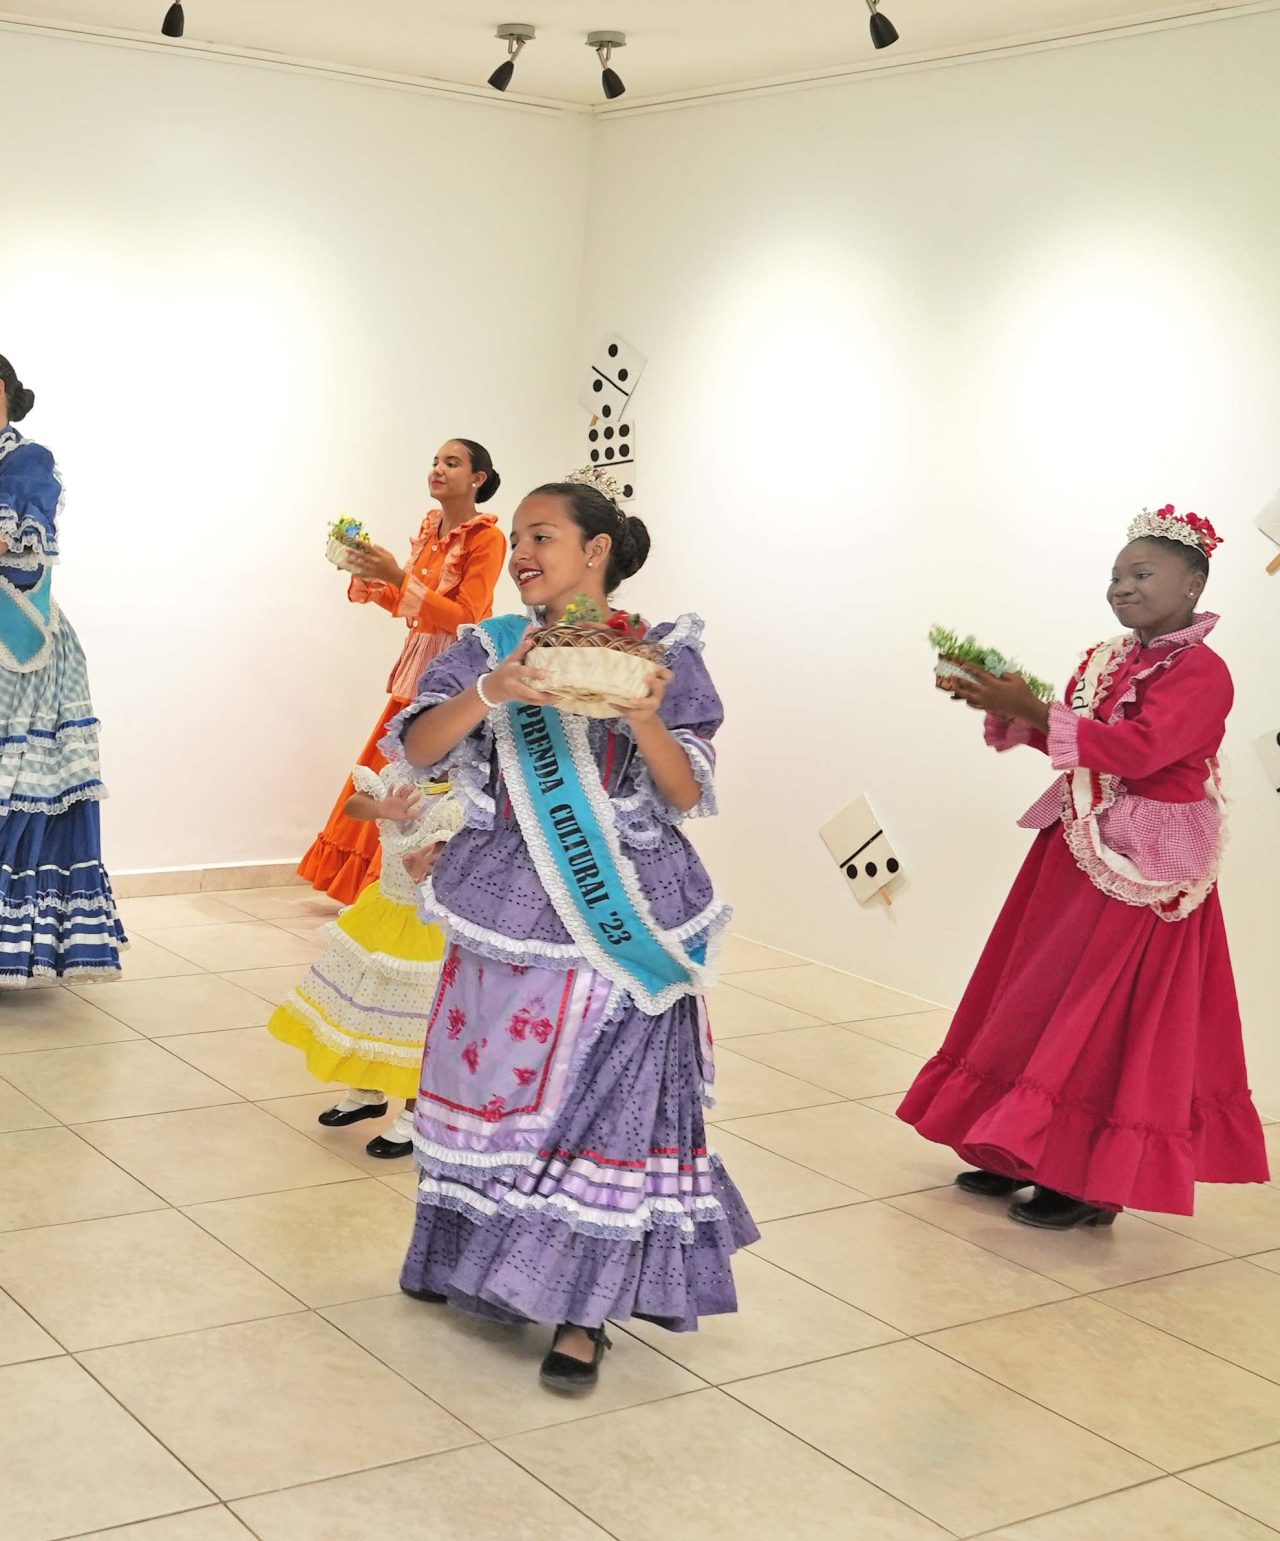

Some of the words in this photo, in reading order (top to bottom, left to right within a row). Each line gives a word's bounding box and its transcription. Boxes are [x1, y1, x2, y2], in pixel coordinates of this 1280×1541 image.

[516, 704, 564, 796] PRENDA
[549, 803, 610, 910] CULTURAL
[598, 910, 632, 946] '23
